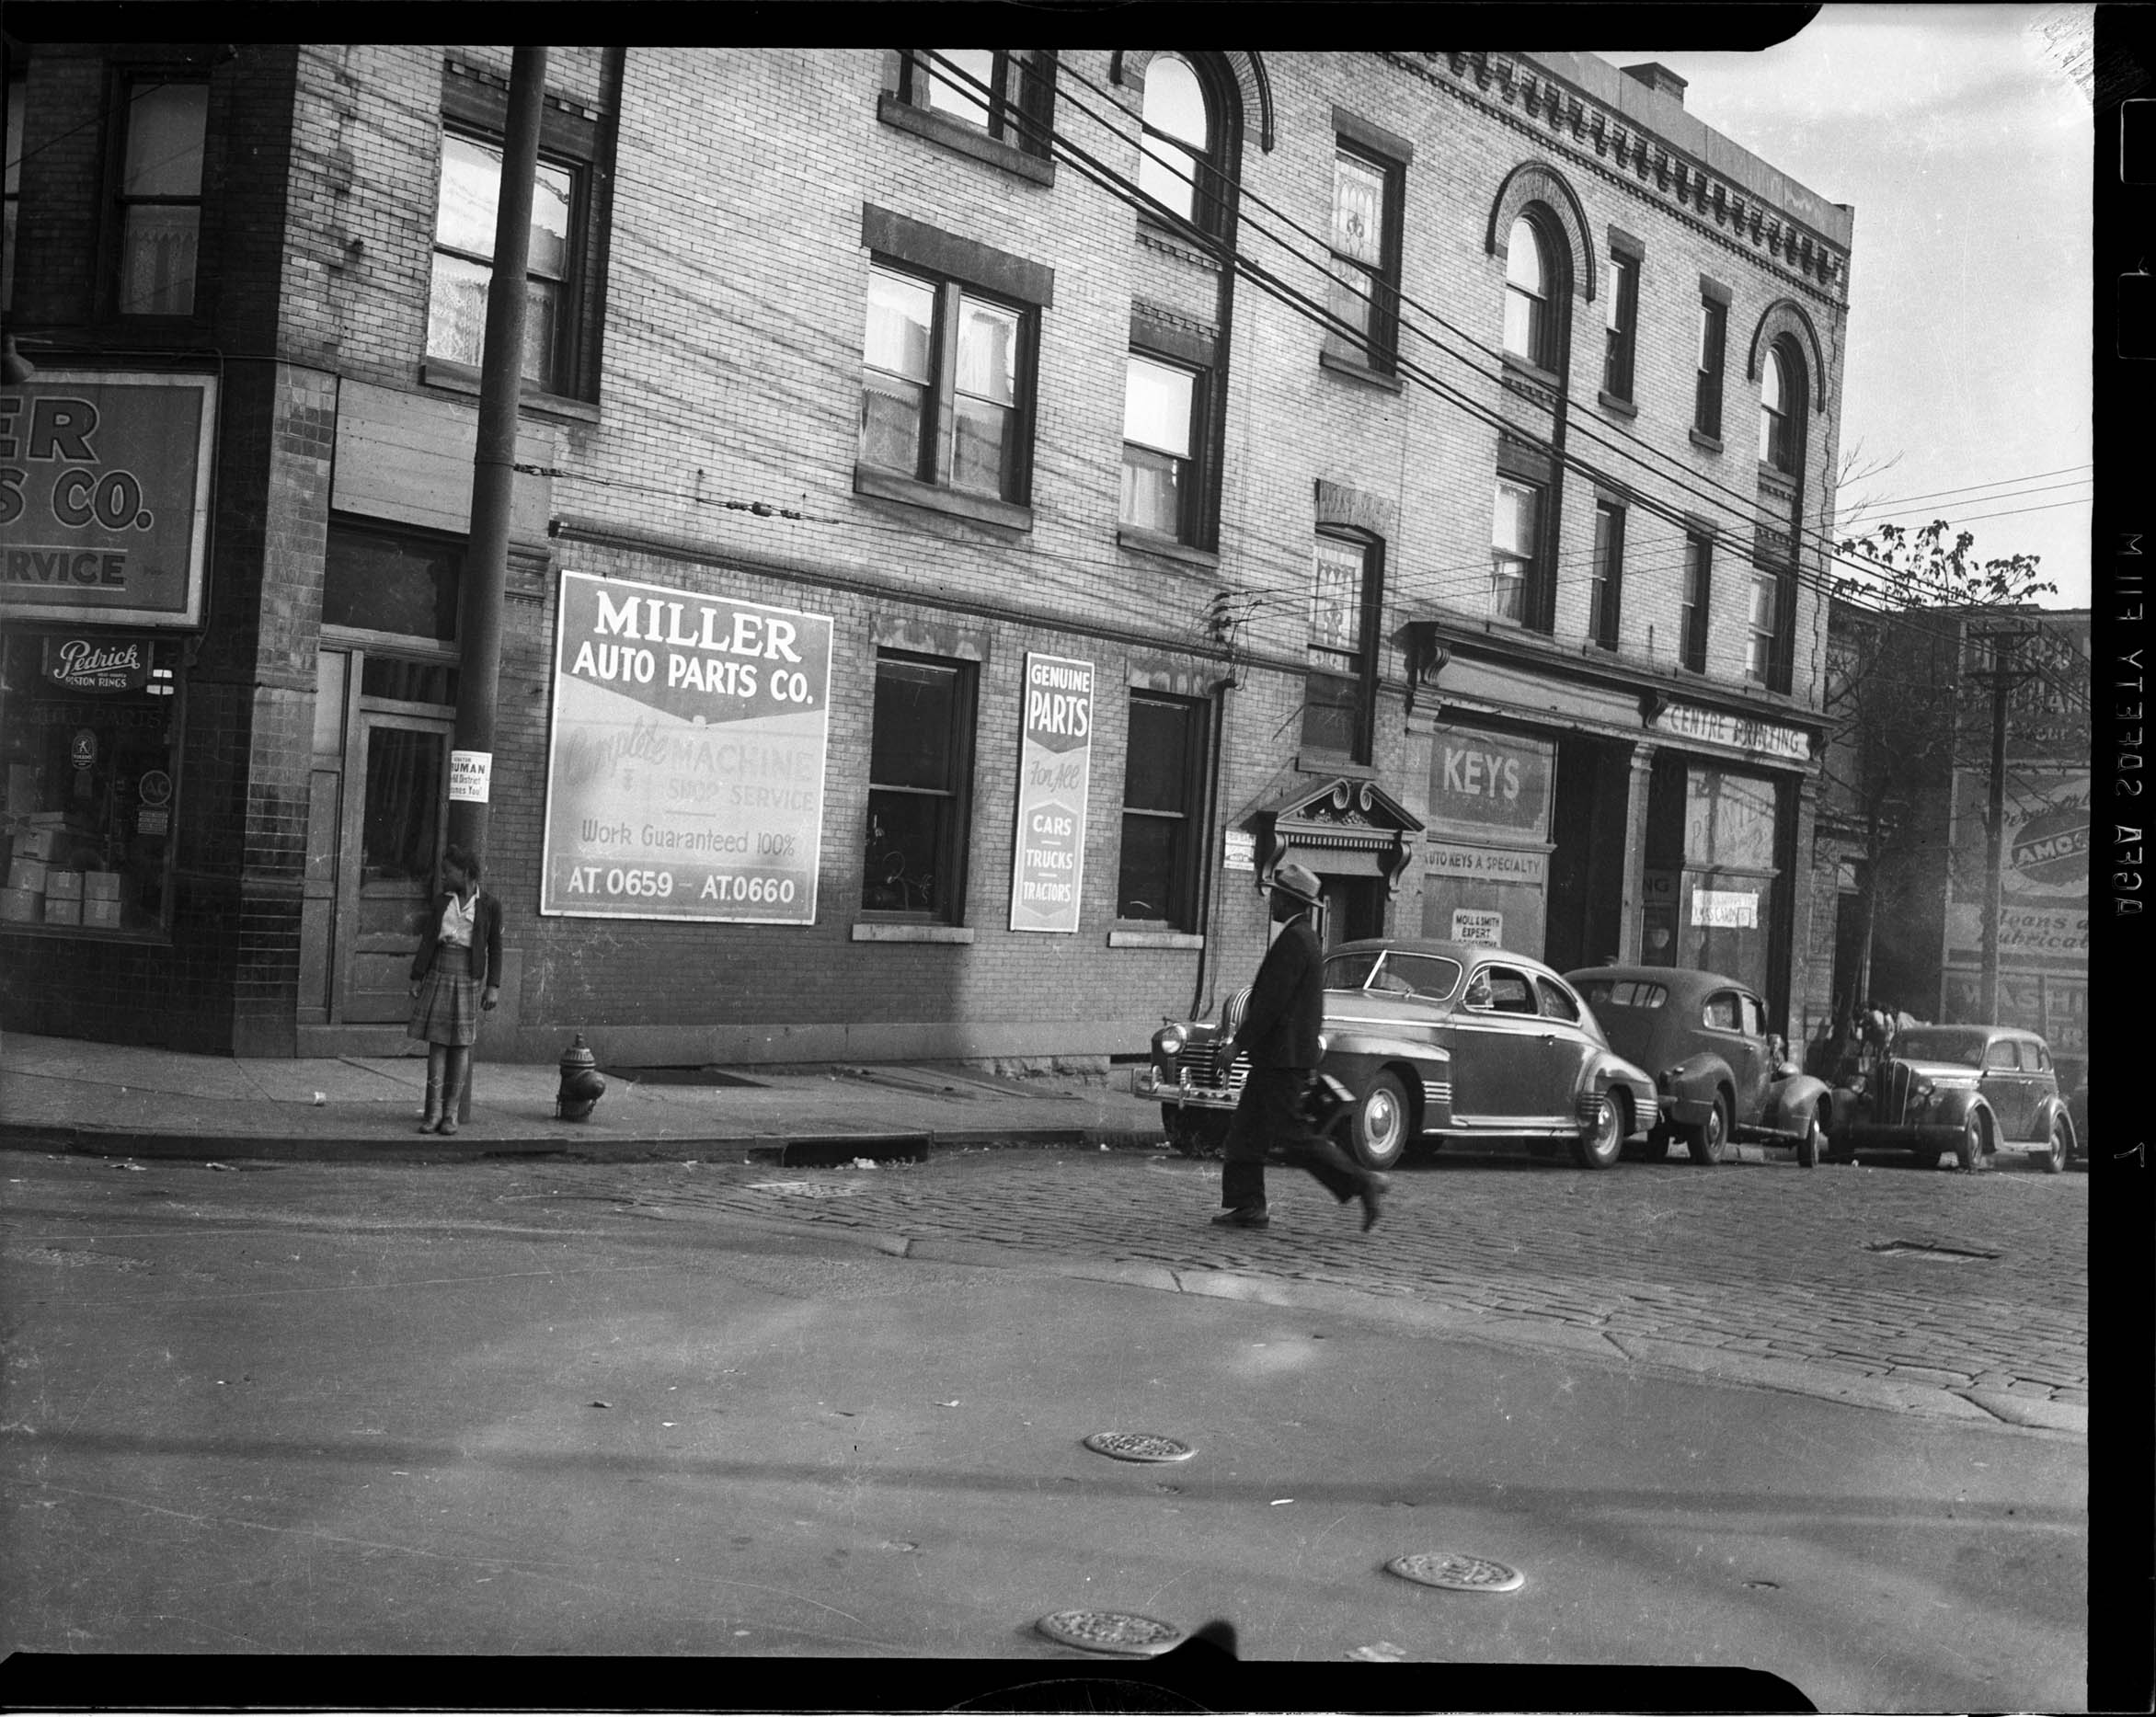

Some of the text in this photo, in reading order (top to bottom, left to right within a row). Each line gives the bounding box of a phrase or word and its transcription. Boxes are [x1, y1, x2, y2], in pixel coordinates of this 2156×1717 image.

[52, 467, 154, 532] CO.
[593, 590, 802, 663] MILLER
[53, 640, 141, 679] Pedrick
[572, 641, 813, 704] AUTO PARTS CO.
[65, 676, 127, 688] PISTON RINGS
[1031, 664, 1090, 693] GENUINE
[1029, 691, 1088, 737] PARTS
[672, 741, 815, 780] MACHINE
[1443, 748, 1520, 799] KEYS
[730, 784, 815, 812] SERVICE
[581, 819, 795, 857] Work Guaranteed 100%
[1033, 815, 1072, 836] CARS
[1026, 849, 1073, 870] TRUCKS
[1449, 853, 1473, 869] KEYS
[1475, 855, 1484, 869] A
[1486, 856, 1541, 874] SPECIALTY
[606, 868, 673, 897] 0659
[1023, 881, 1072, 903] TRACTORS
[1462, 926, 1490, 938] EXPERT
